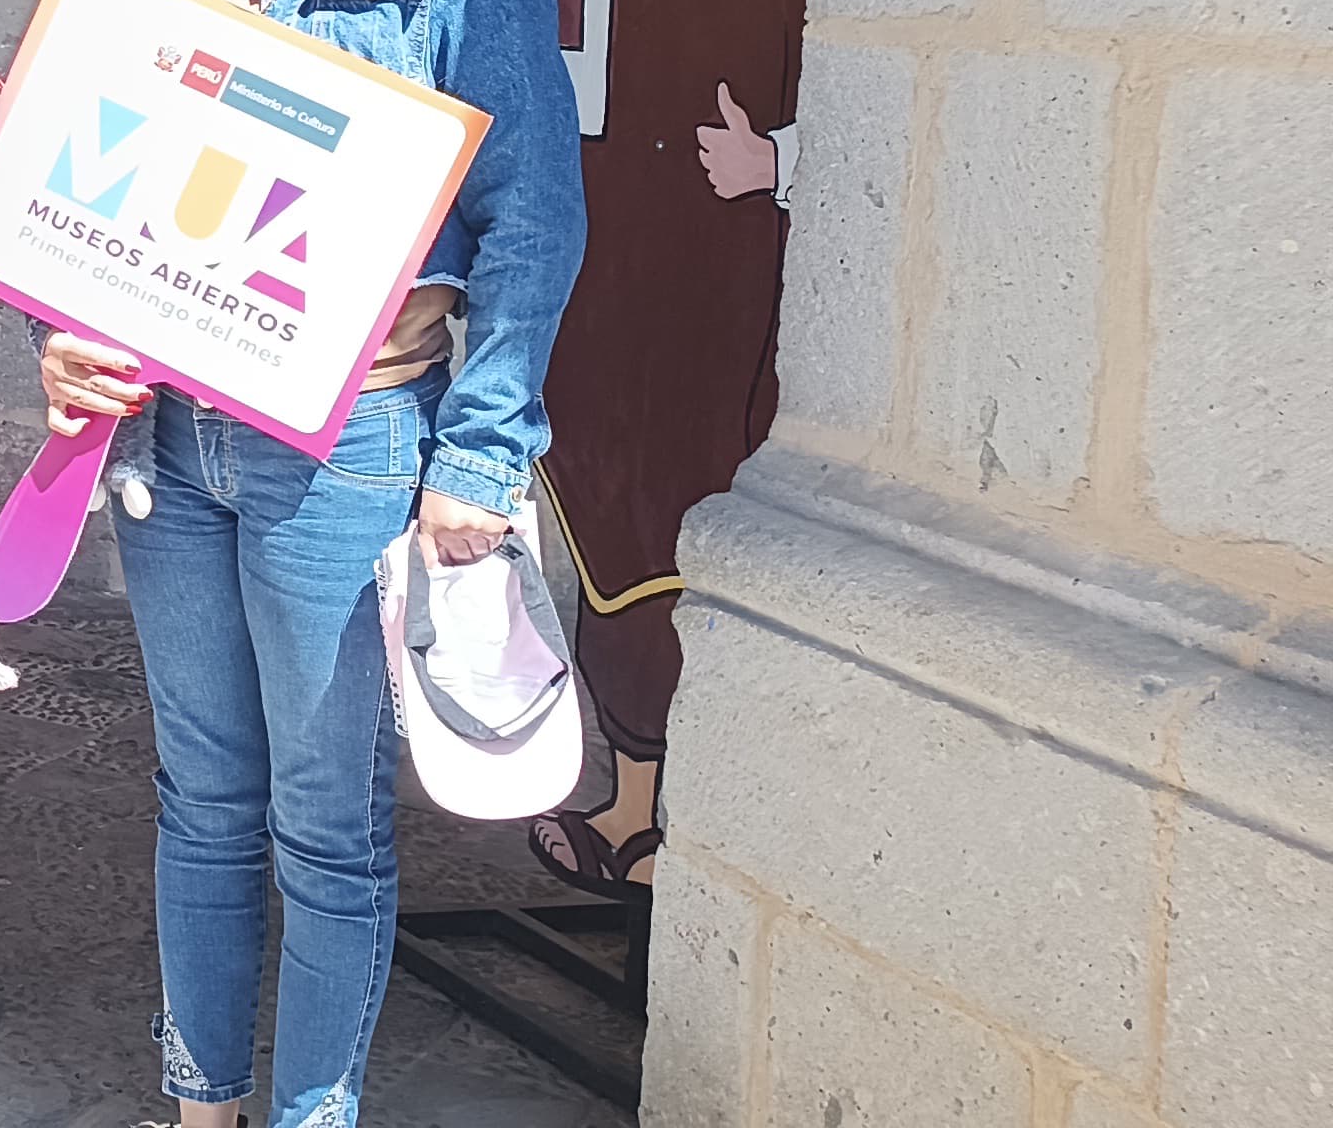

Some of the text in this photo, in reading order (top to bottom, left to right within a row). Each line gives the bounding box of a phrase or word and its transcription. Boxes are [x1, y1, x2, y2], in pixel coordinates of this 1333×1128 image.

[191, 62, 223, 84] PERÚ
[229, 81, 337, 136] Ministerio de Cultura
[18, 225, 283, 368] Primer domingo del mes
[27, 199, 299, 342] MUSEOS ABIERTOS
